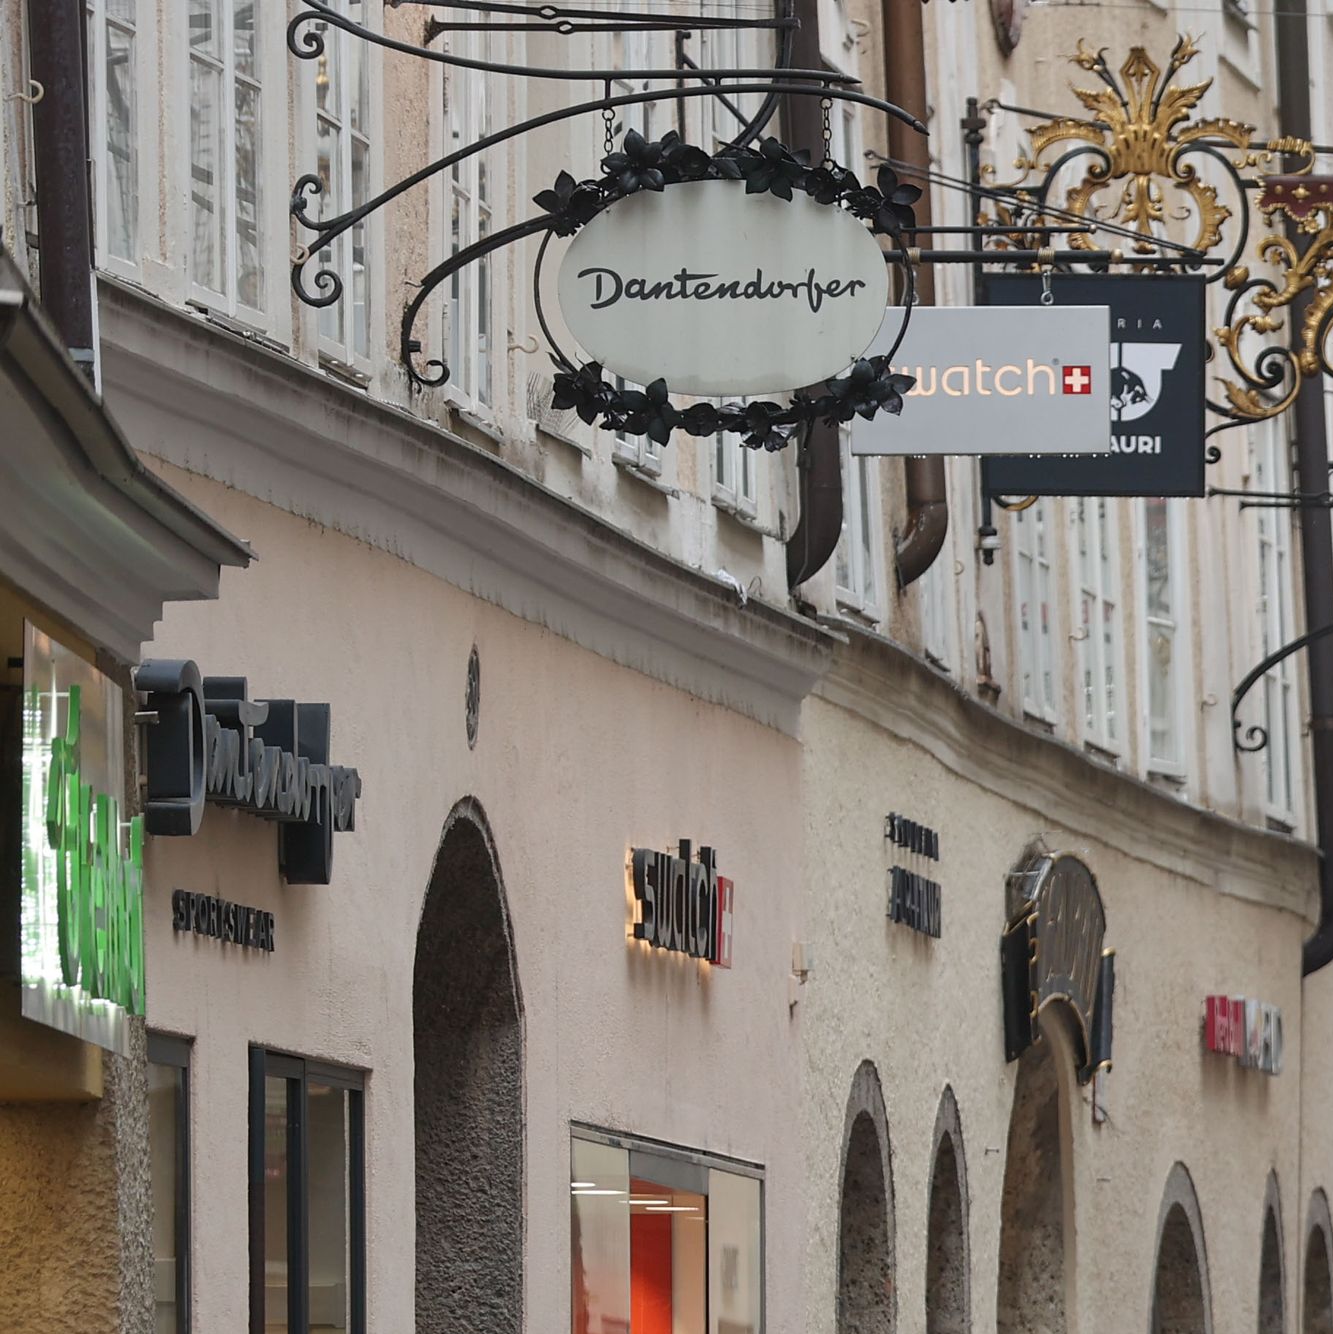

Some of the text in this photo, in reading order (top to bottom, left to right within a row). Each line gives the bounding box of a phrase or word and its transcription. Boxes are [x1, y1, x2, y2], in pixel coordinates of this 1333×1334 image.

[577, 267, 866, 313] Dantendorfer
[889, 359, 1056, 397] watch
[171, 888, 275, 952] SPORTSWEAR
